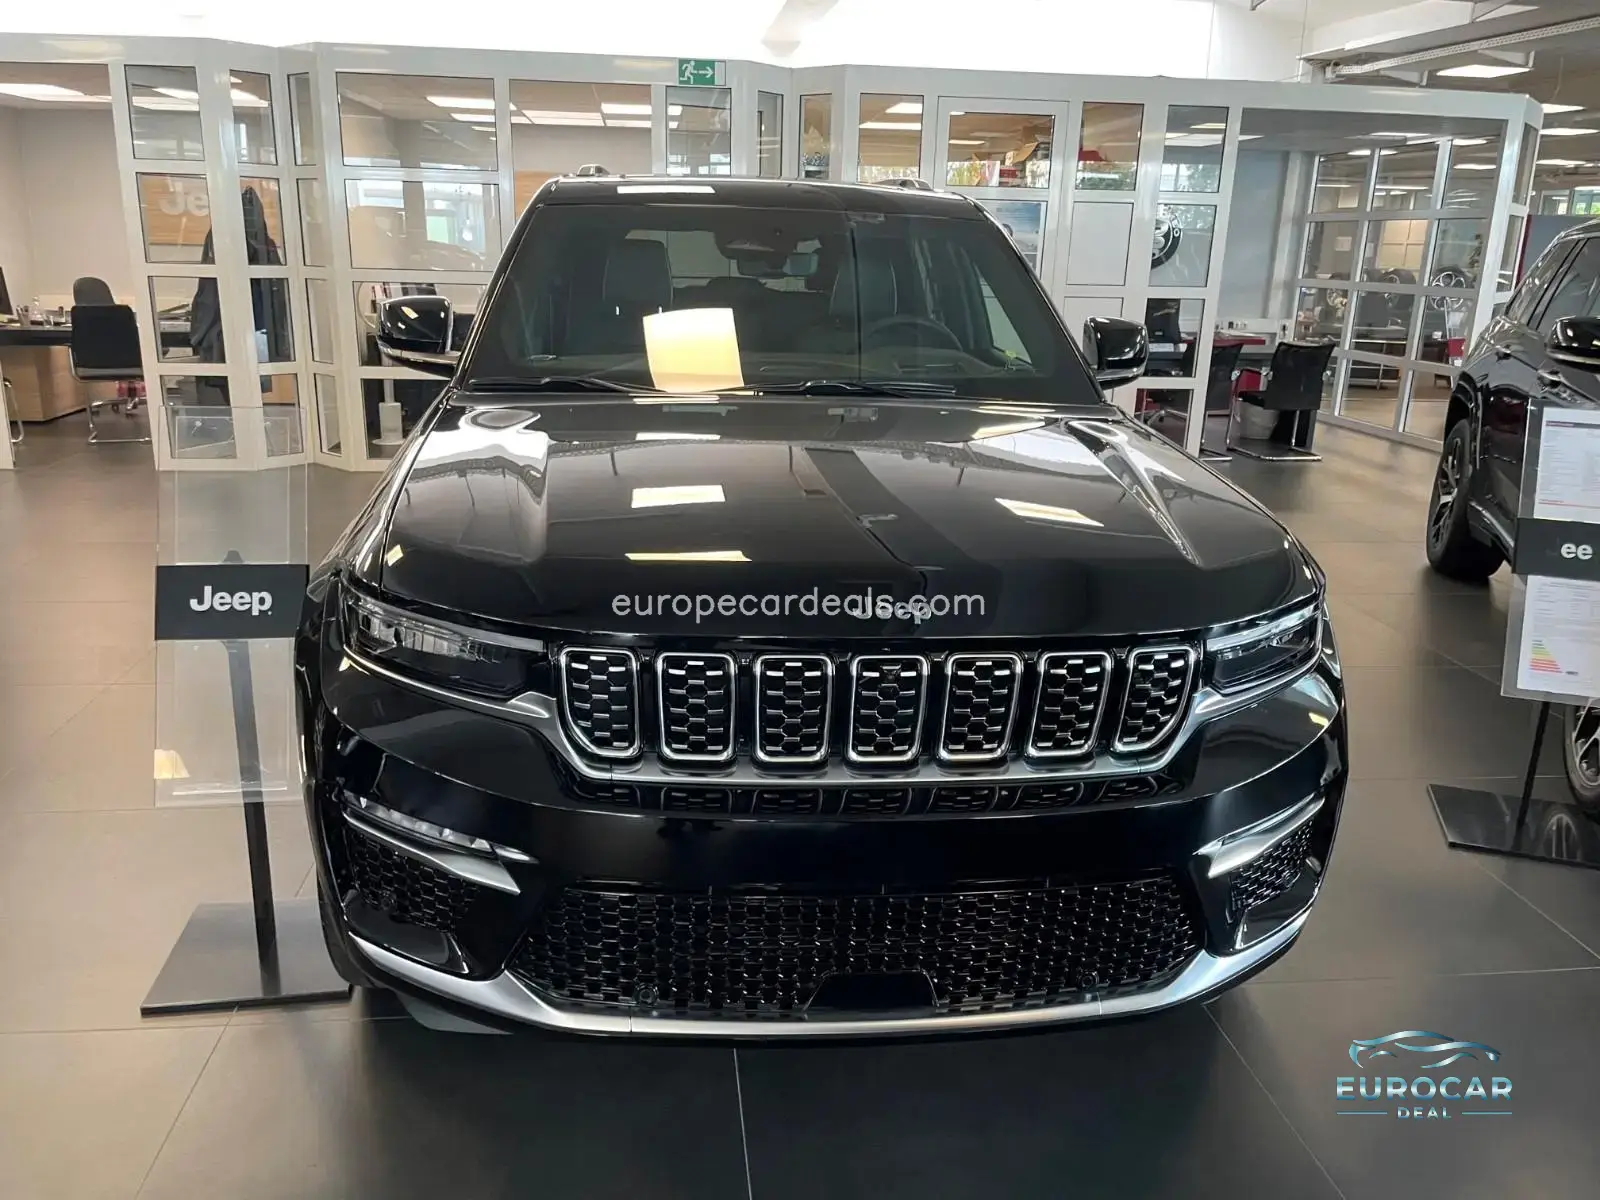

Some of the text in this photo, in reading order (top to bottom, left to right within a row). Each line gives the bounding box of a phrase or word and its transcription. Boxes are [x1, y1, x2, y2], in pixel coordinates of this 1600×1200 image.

[159, 181, 209, 217] Je
[189, 585, 273, 616] Jeep
[852, 596, 932, 625] Jeep
